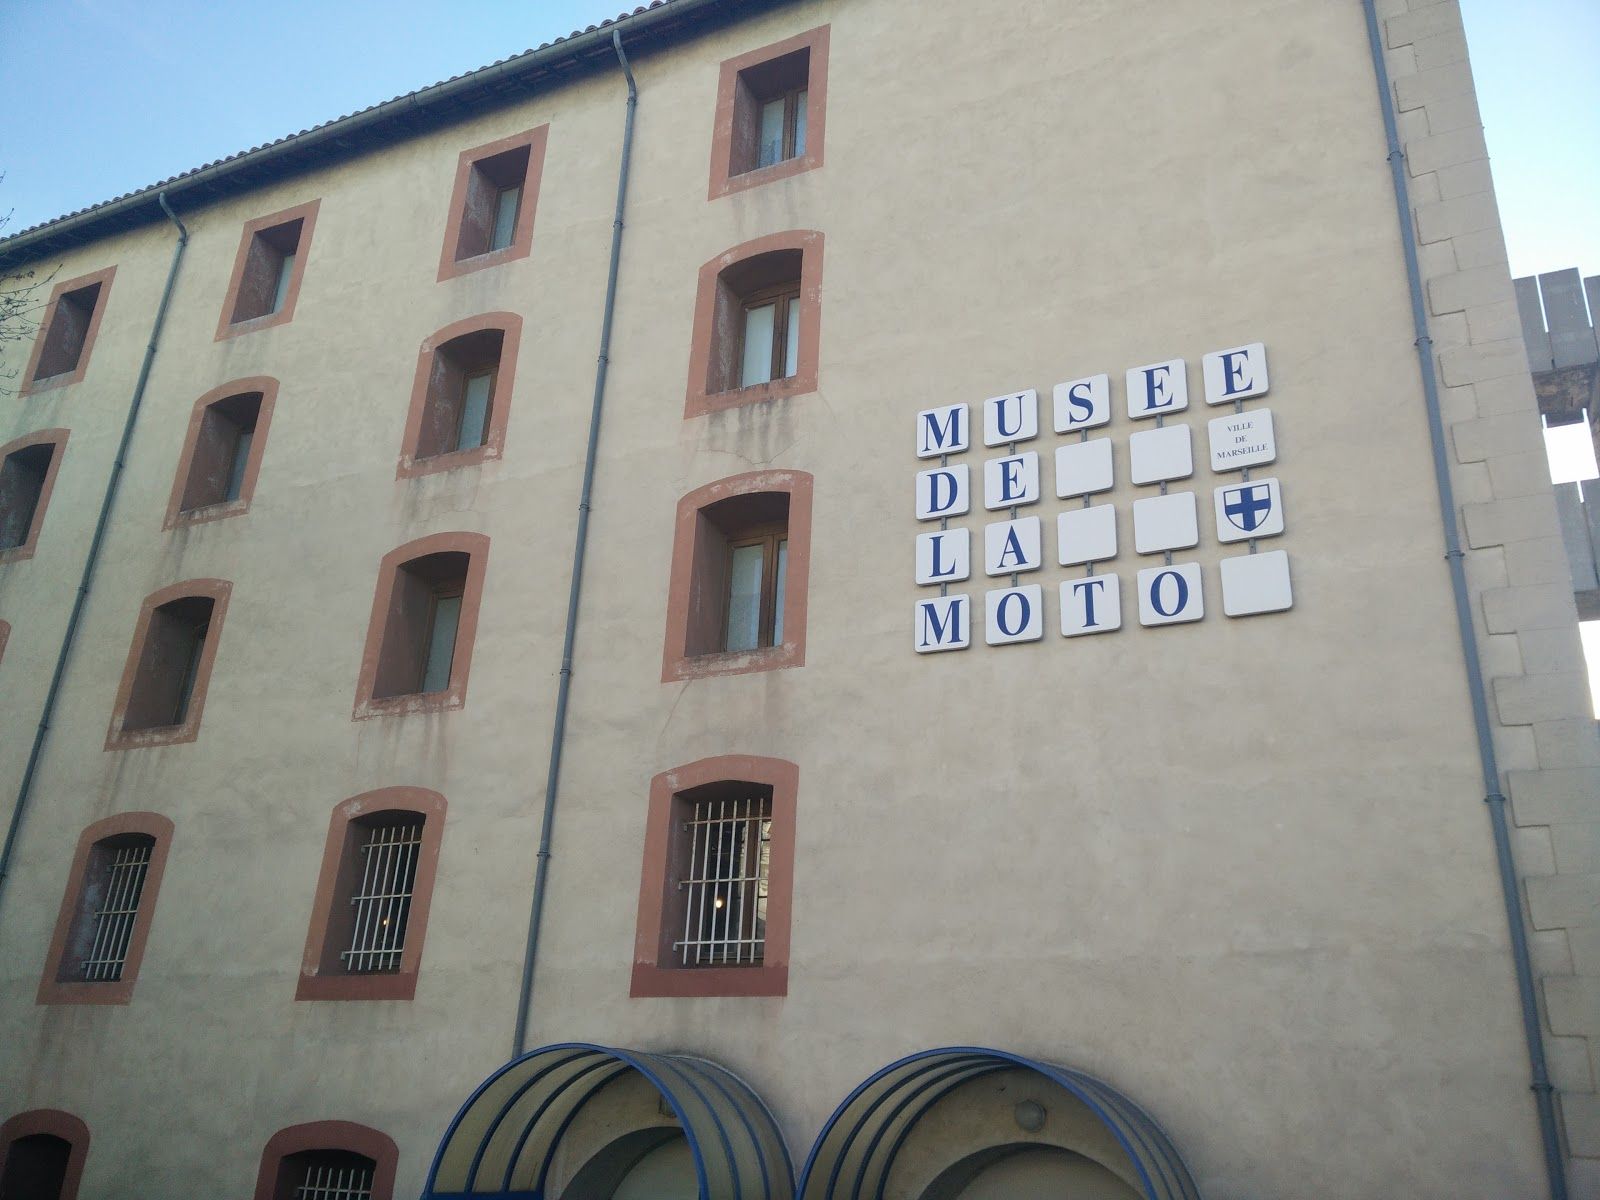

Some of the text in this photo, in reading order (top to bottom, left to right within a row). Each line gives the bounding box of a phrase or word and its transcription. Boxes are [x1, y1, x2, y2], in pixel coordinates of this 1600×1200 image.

[922, 349, 1254, 452] MUSEE
[1227, 421, 1254, 432] VILLE
[1216, 443, 1268, 458] MARSEILLE
[1235, 435, 1247, 443] DE
[926, 458, 1027, 514] DE
[929, 524, 1029, 578] LA
[919, 571, 1189, 647] MOTO
